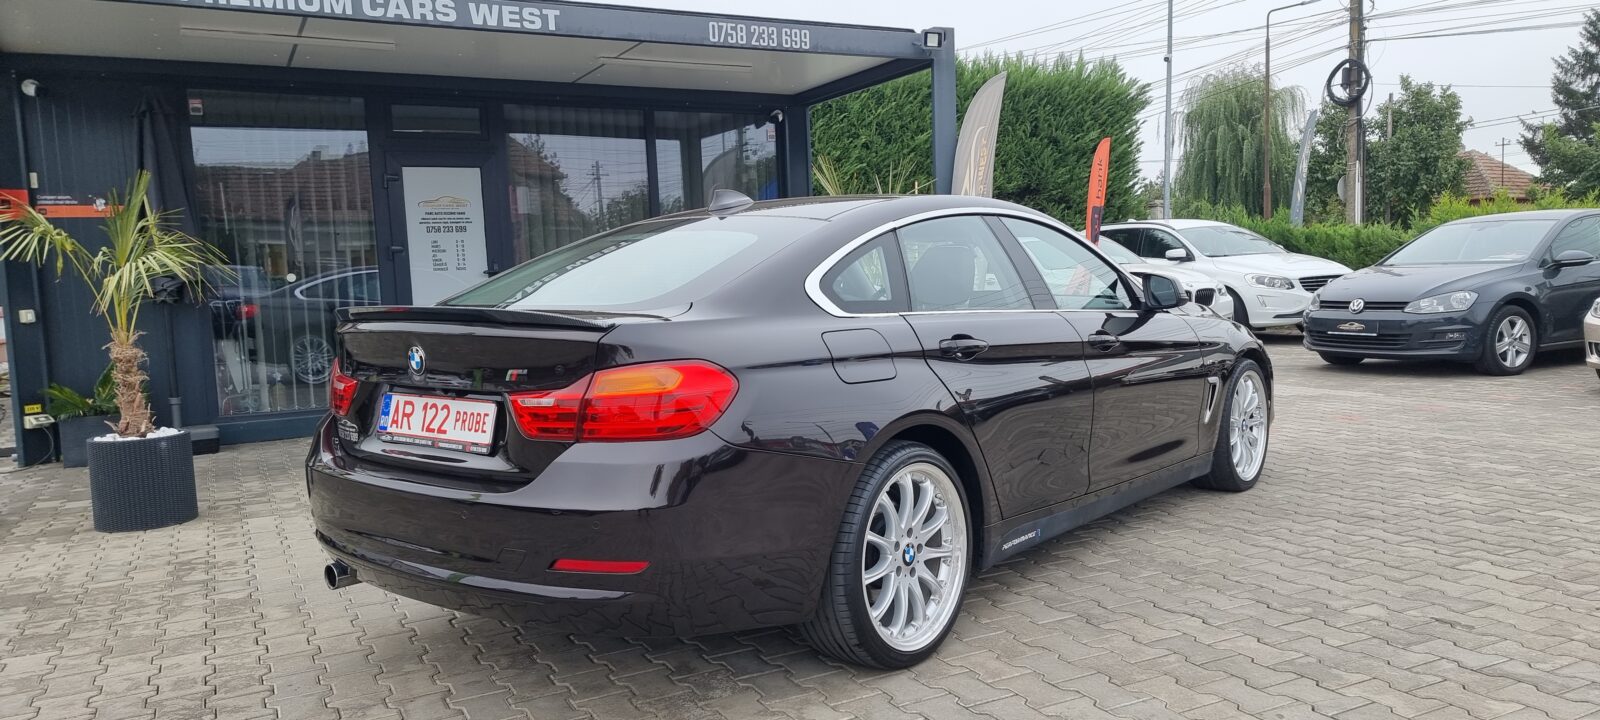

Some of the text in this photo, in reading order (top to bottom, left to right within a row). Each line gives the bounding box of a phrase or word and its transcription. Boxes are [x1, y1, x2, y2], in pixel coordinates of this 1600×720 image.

[362, 0, 457, 22] CARS
[468, 2, 560, 31] WEST
[709, 21, 810, 49] 0758 233 699
[426, 225, 442, 233] 0758
[442, 225, 454, 233] 233
[390, 399, 490, 434] AR 122 PROBE
